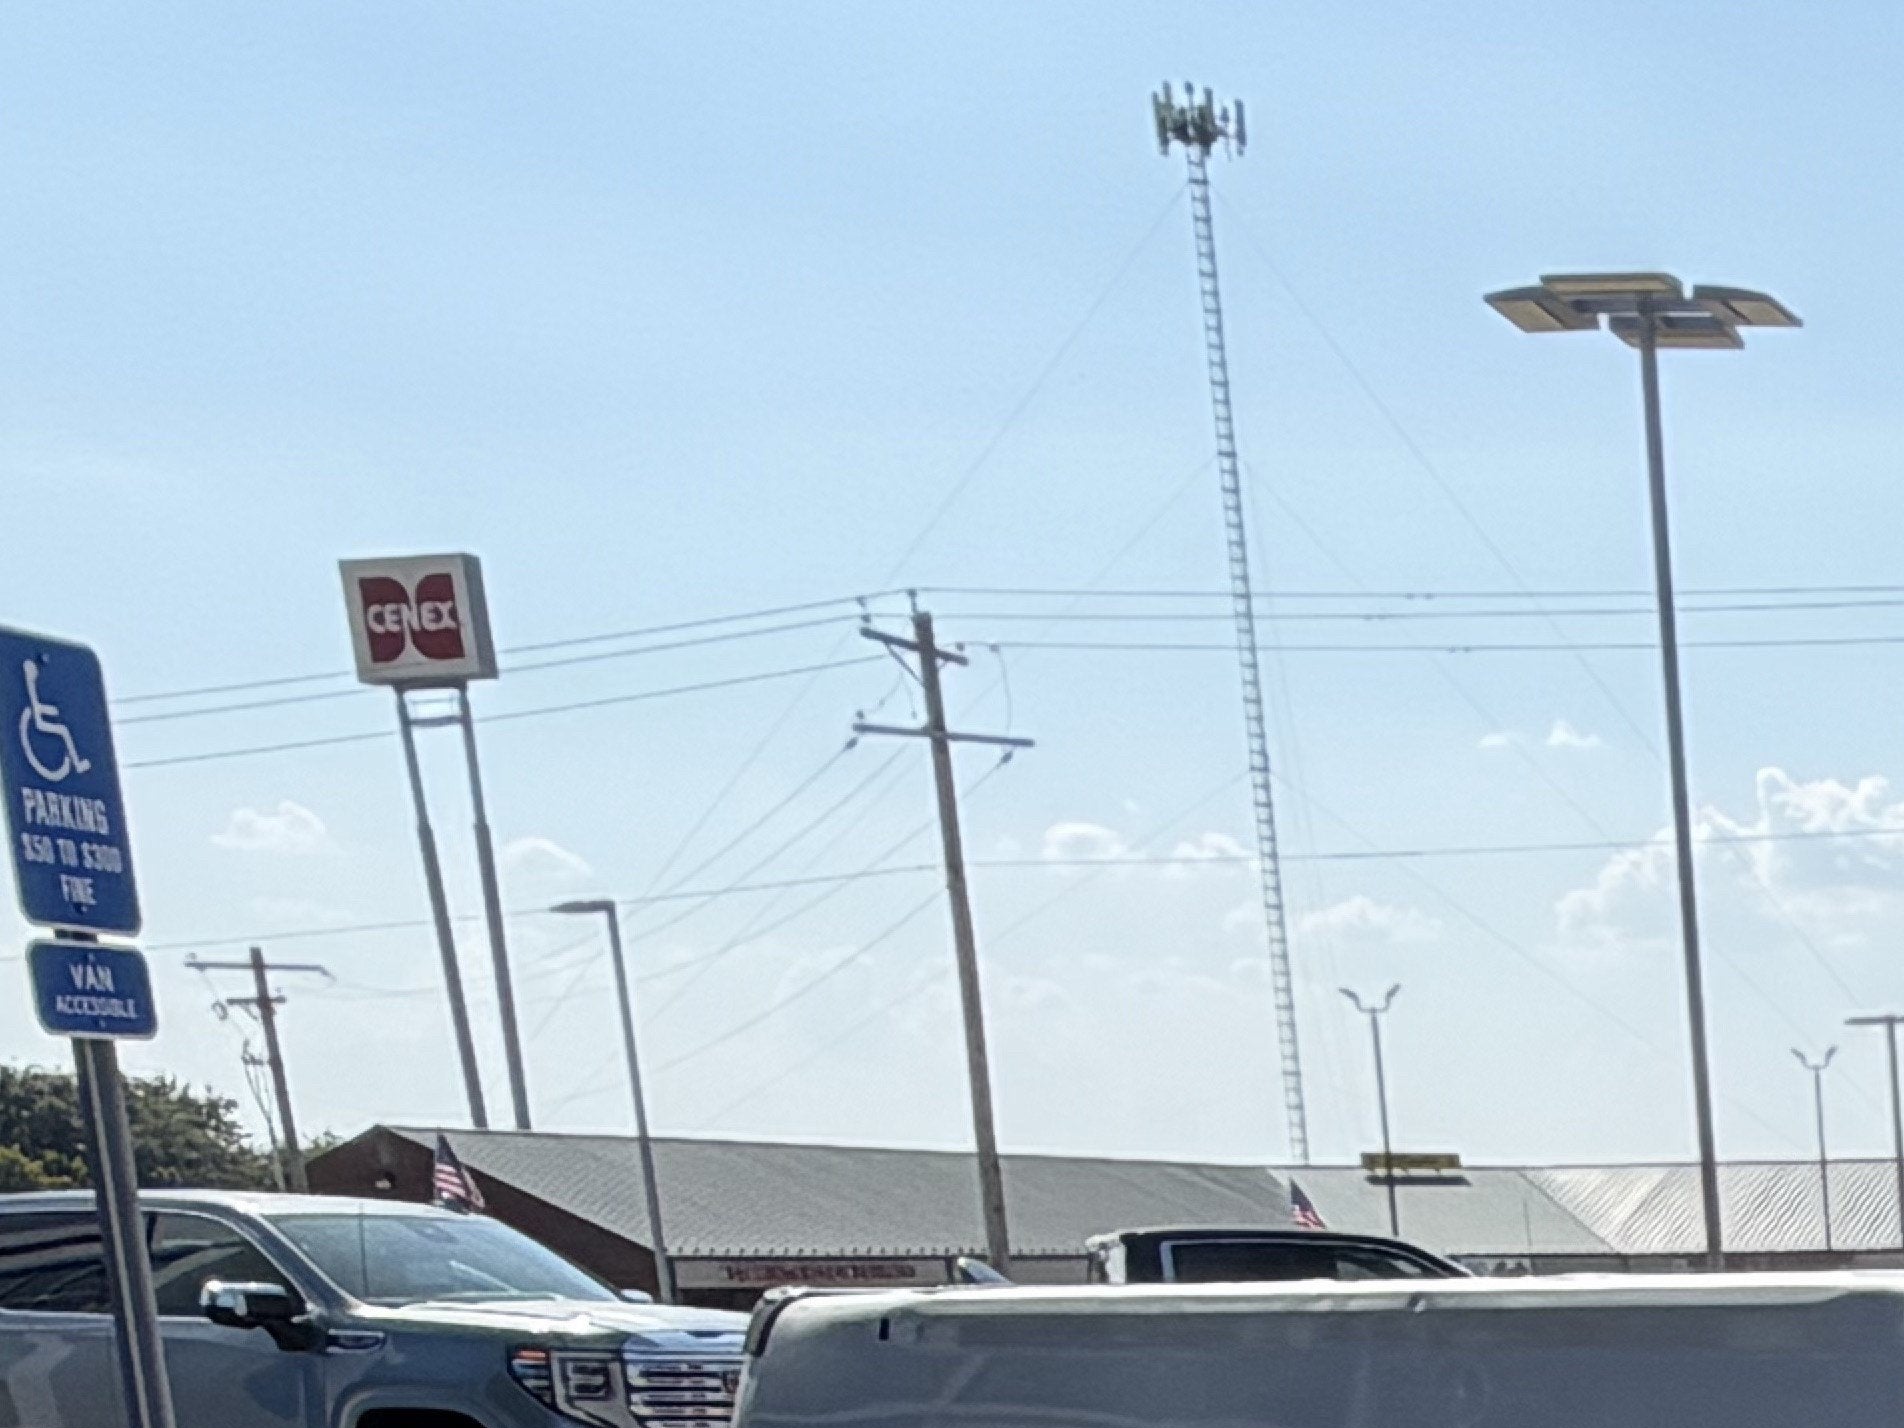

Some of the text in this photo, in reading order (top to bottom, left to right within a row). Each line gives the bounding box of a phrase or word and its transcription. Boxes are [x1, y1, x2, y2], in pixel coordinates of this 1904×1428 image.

[365, 601, 459, 633] CENEX
[21, 786, 109, 835] PARKING
[57, 838, 79, 868] TO
[60, 873, 97, 905] FINE
[69, 963, 115, 993] VAN
[55, 994, 138, 1020] ACCESSIBLE
